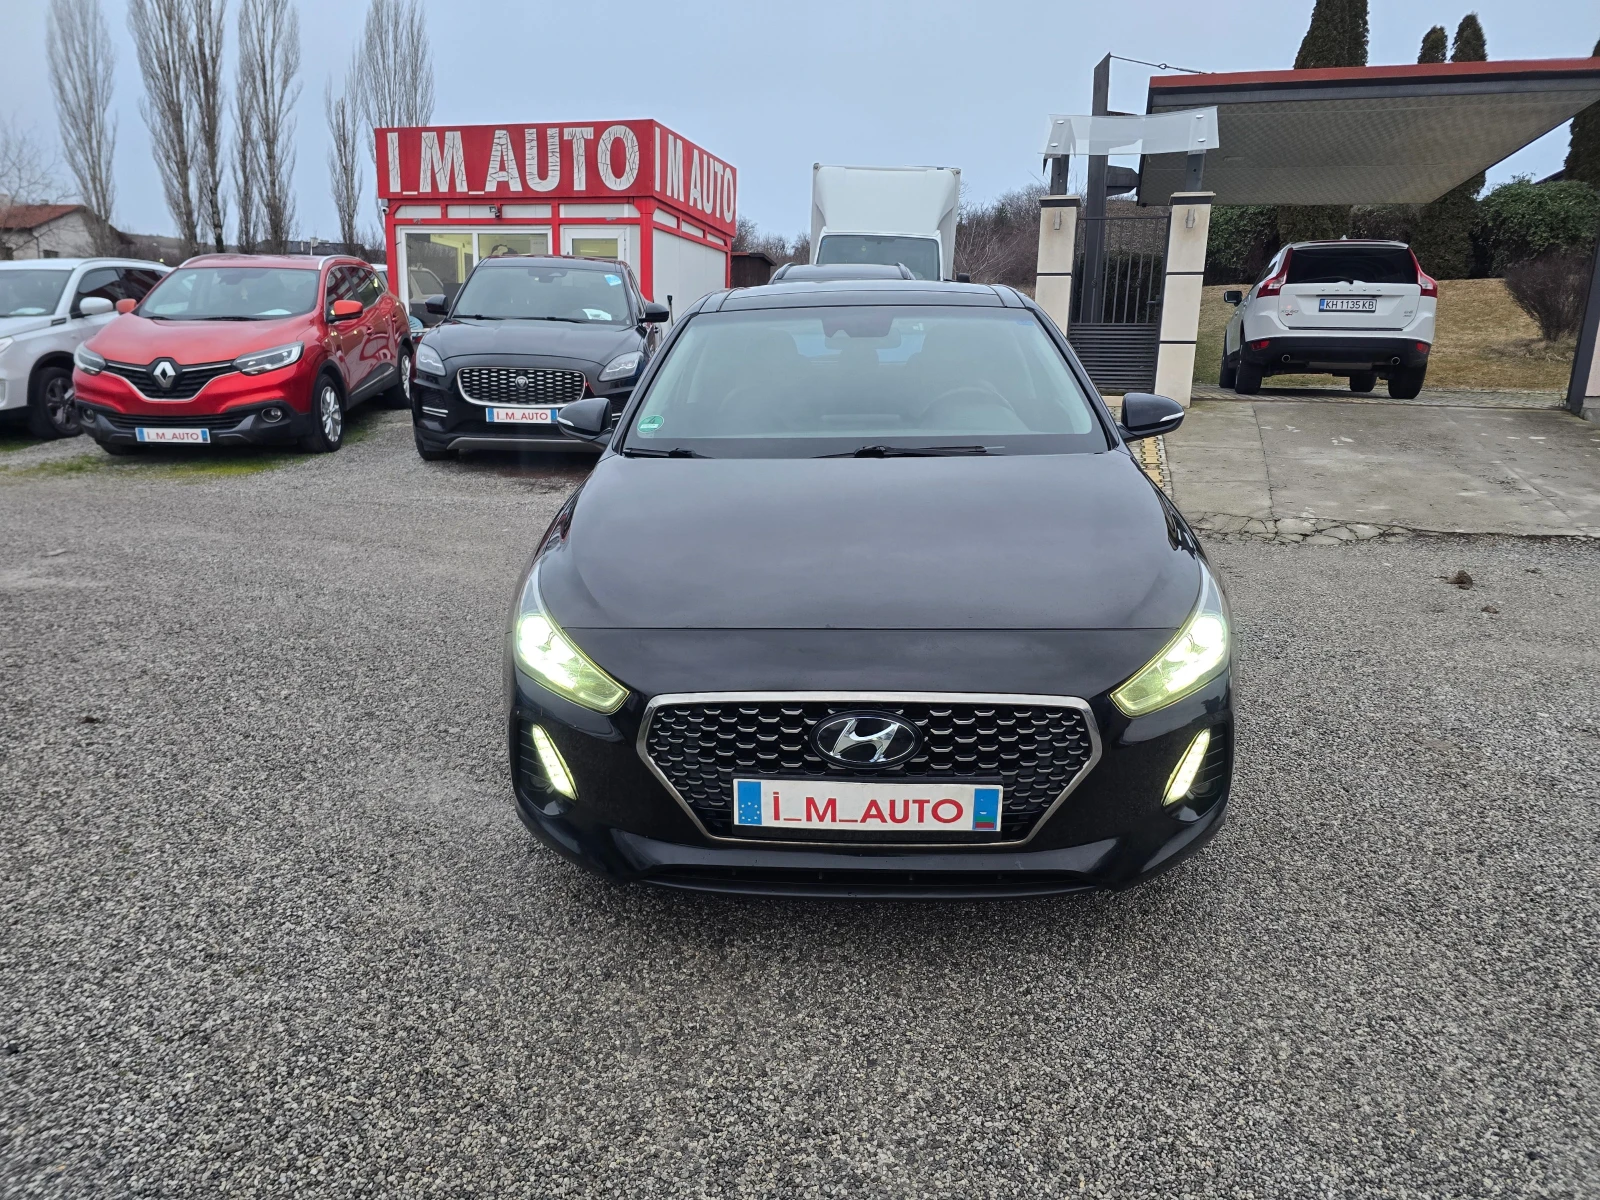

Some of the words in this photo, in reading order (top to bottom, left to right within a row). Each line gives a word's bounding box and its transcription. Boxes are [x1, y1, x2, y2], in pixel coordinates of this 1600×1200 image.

[655, 127, 660, 192] I
[666, 133, 684, 203] M
[689, 148, 734, 224] AUTO
[1325, 300, 1338, 309] KH
[1340, 300, 1361, 309] 1135
[1361, 300, 1375, 310] KB
